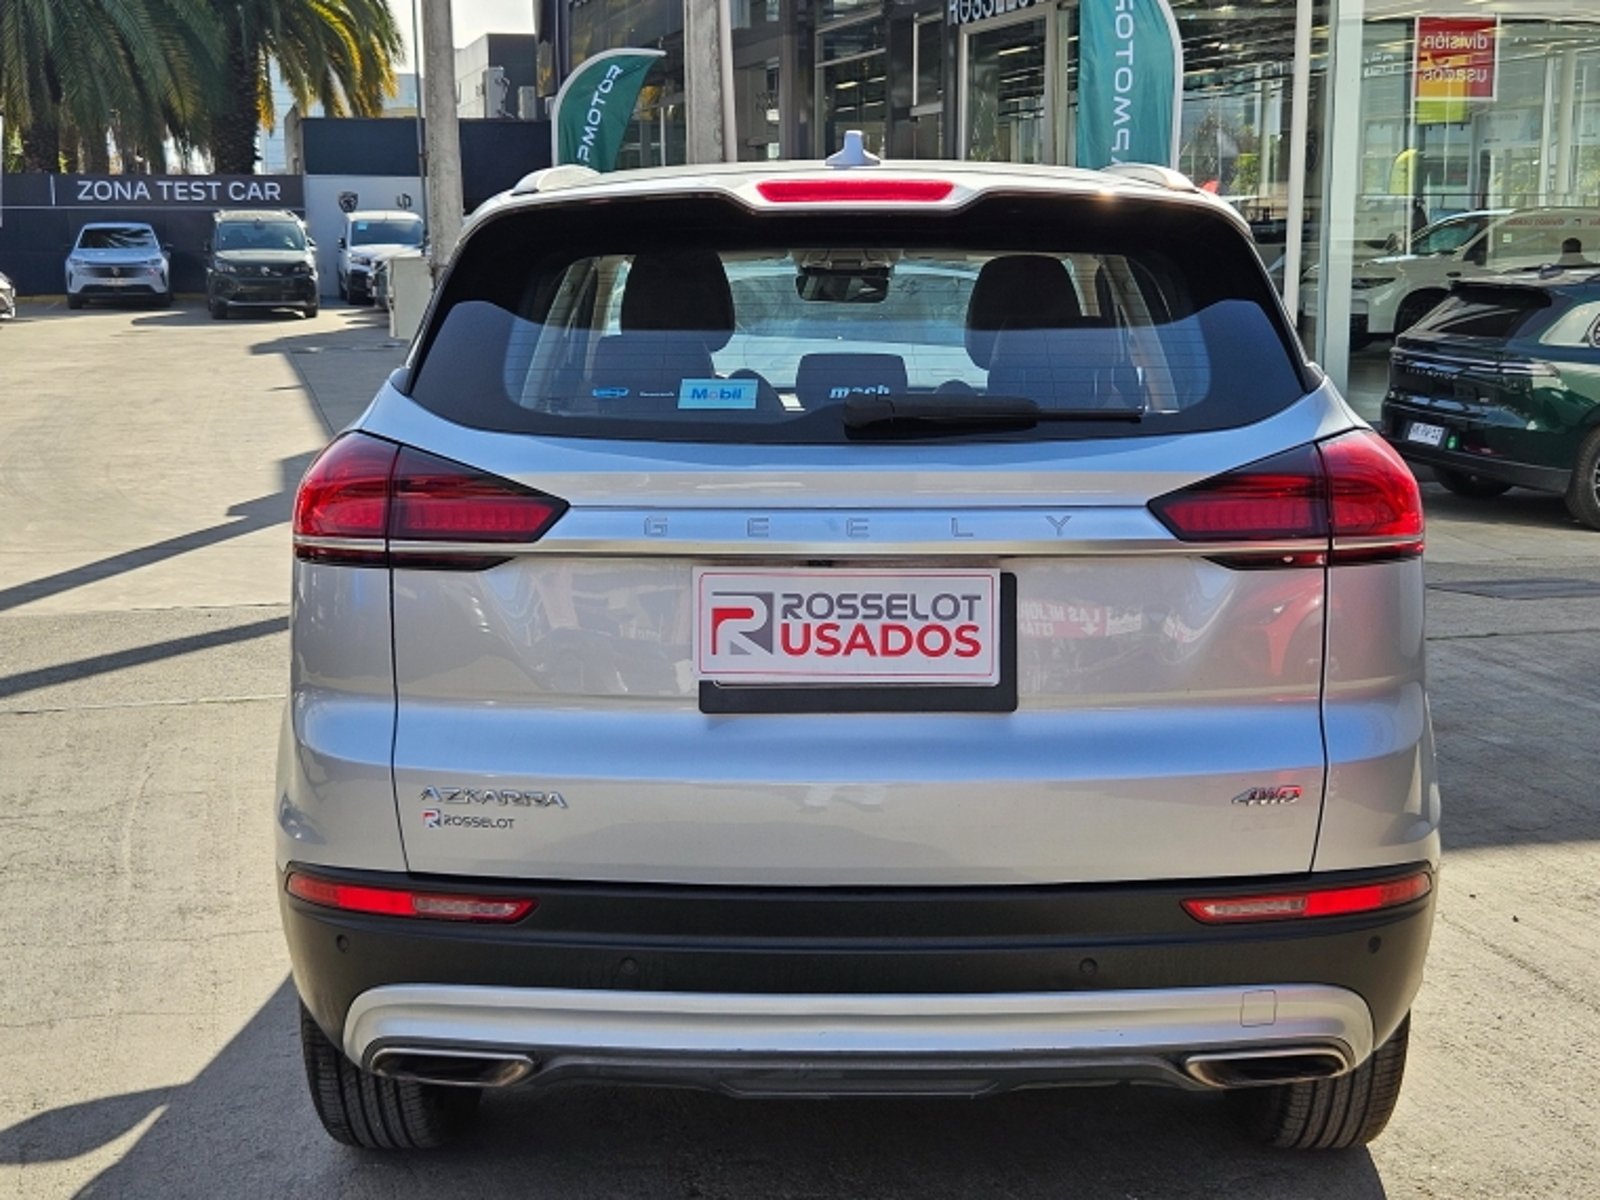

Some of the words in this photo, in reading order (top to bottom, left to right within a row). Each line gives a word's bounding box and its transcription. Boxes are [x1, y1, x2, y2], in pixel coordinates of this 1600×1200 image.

[77, 180, 151, 200] ZONA
[156, 181, 222, 200] TEST
[228, 182, 281, 200] CAR
[691, 388, 742, 401] Mobil
[781, 592, 982, 621] ROSSELOT
[781, 622, 982, 658] USADOS
[421, 785, 569, 809] AZKARRA
[1231, 785, 1303, 806] 4WD
[444, 814, 515, 829] ROSSELOT
